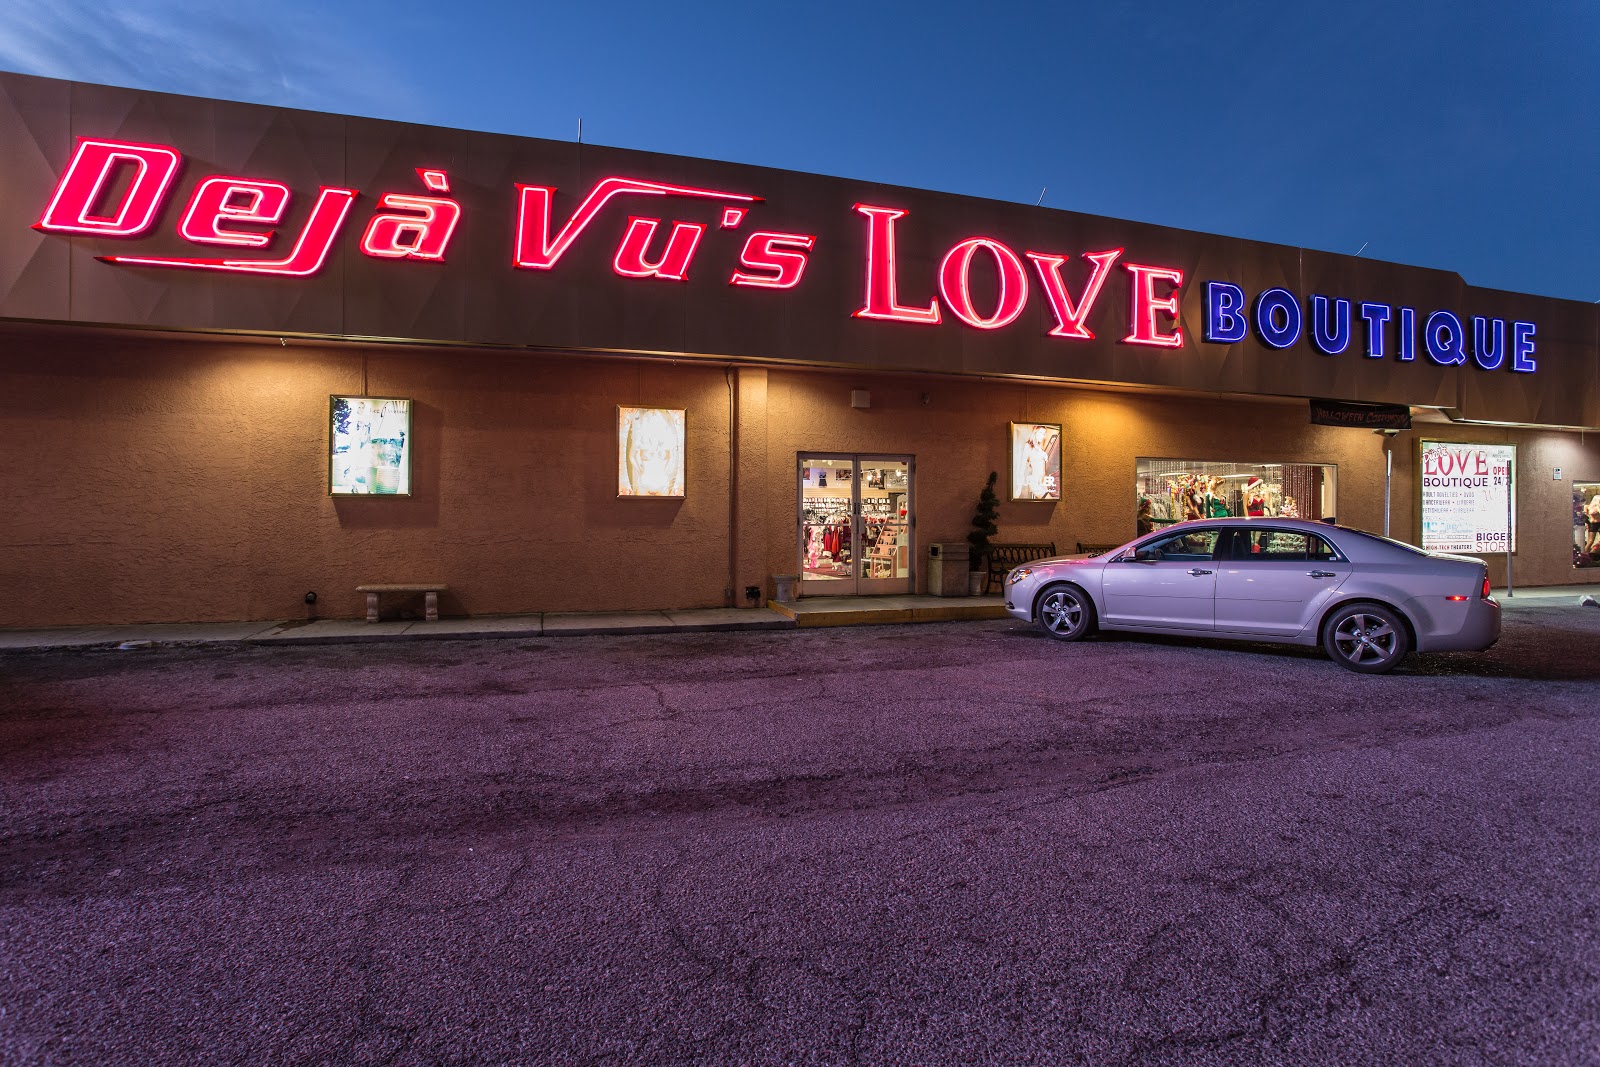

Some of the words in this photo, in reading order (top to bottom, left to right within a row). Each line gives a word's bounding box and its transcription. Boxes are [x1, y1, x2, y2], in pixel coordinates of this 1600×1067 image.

[513, 175, 817, 289] Vu's
[851, 202, 1184, 349] LOVE
[1204, 279, 1538, 374] BOUTIQUE
[1423, 449, 1489, 476] LOVE
[1423, 477, 1489, 489] BOUTIQUE
